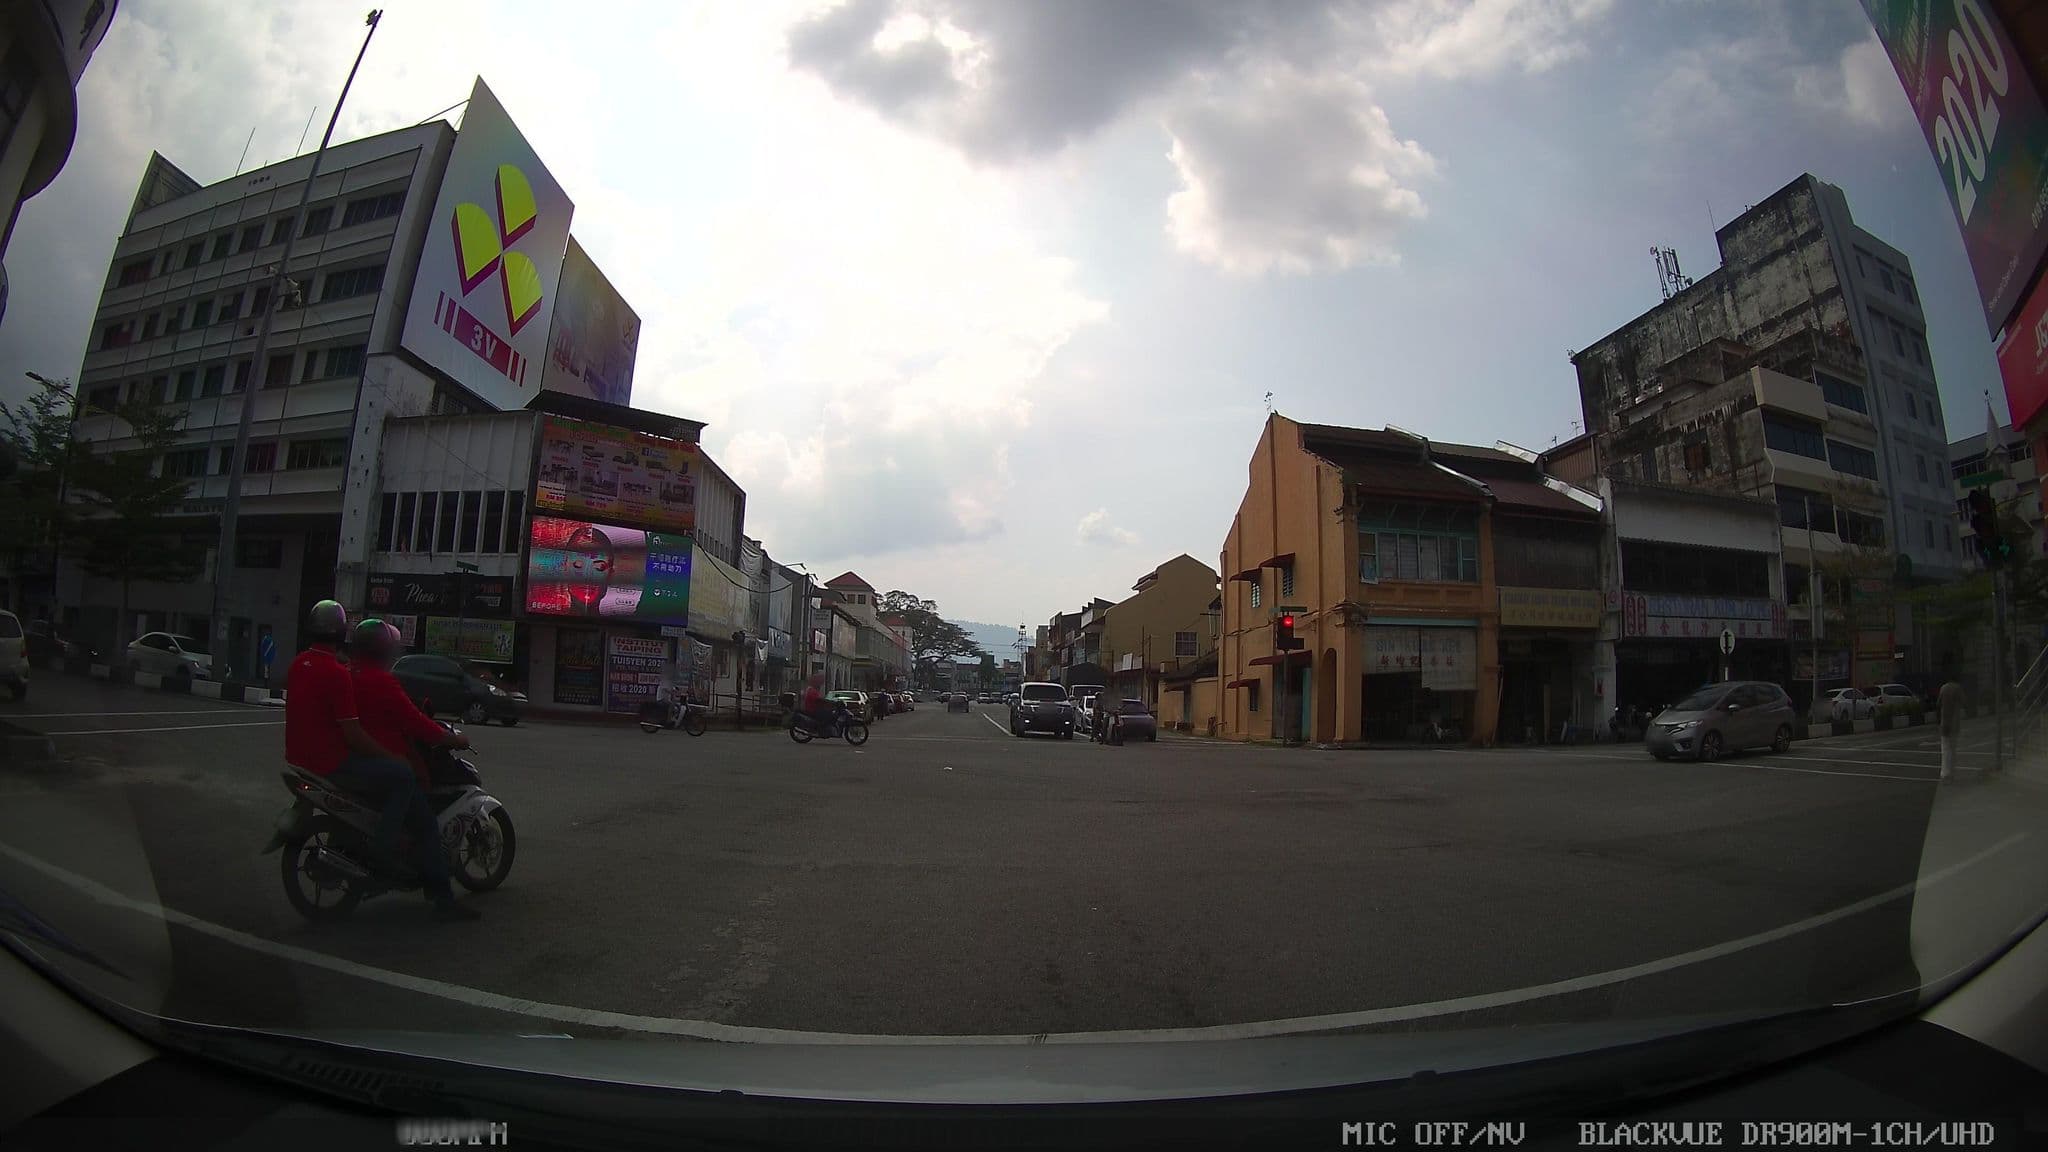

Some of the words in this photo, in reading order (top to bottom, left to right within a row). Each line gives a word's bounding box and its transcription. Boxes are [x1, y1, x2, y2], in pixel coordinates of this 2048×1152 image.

[1935, 0, 2008, 226] 2020
[471, 326, 498, 360] 3V
[616, 646, 662, 654] TAIPING
